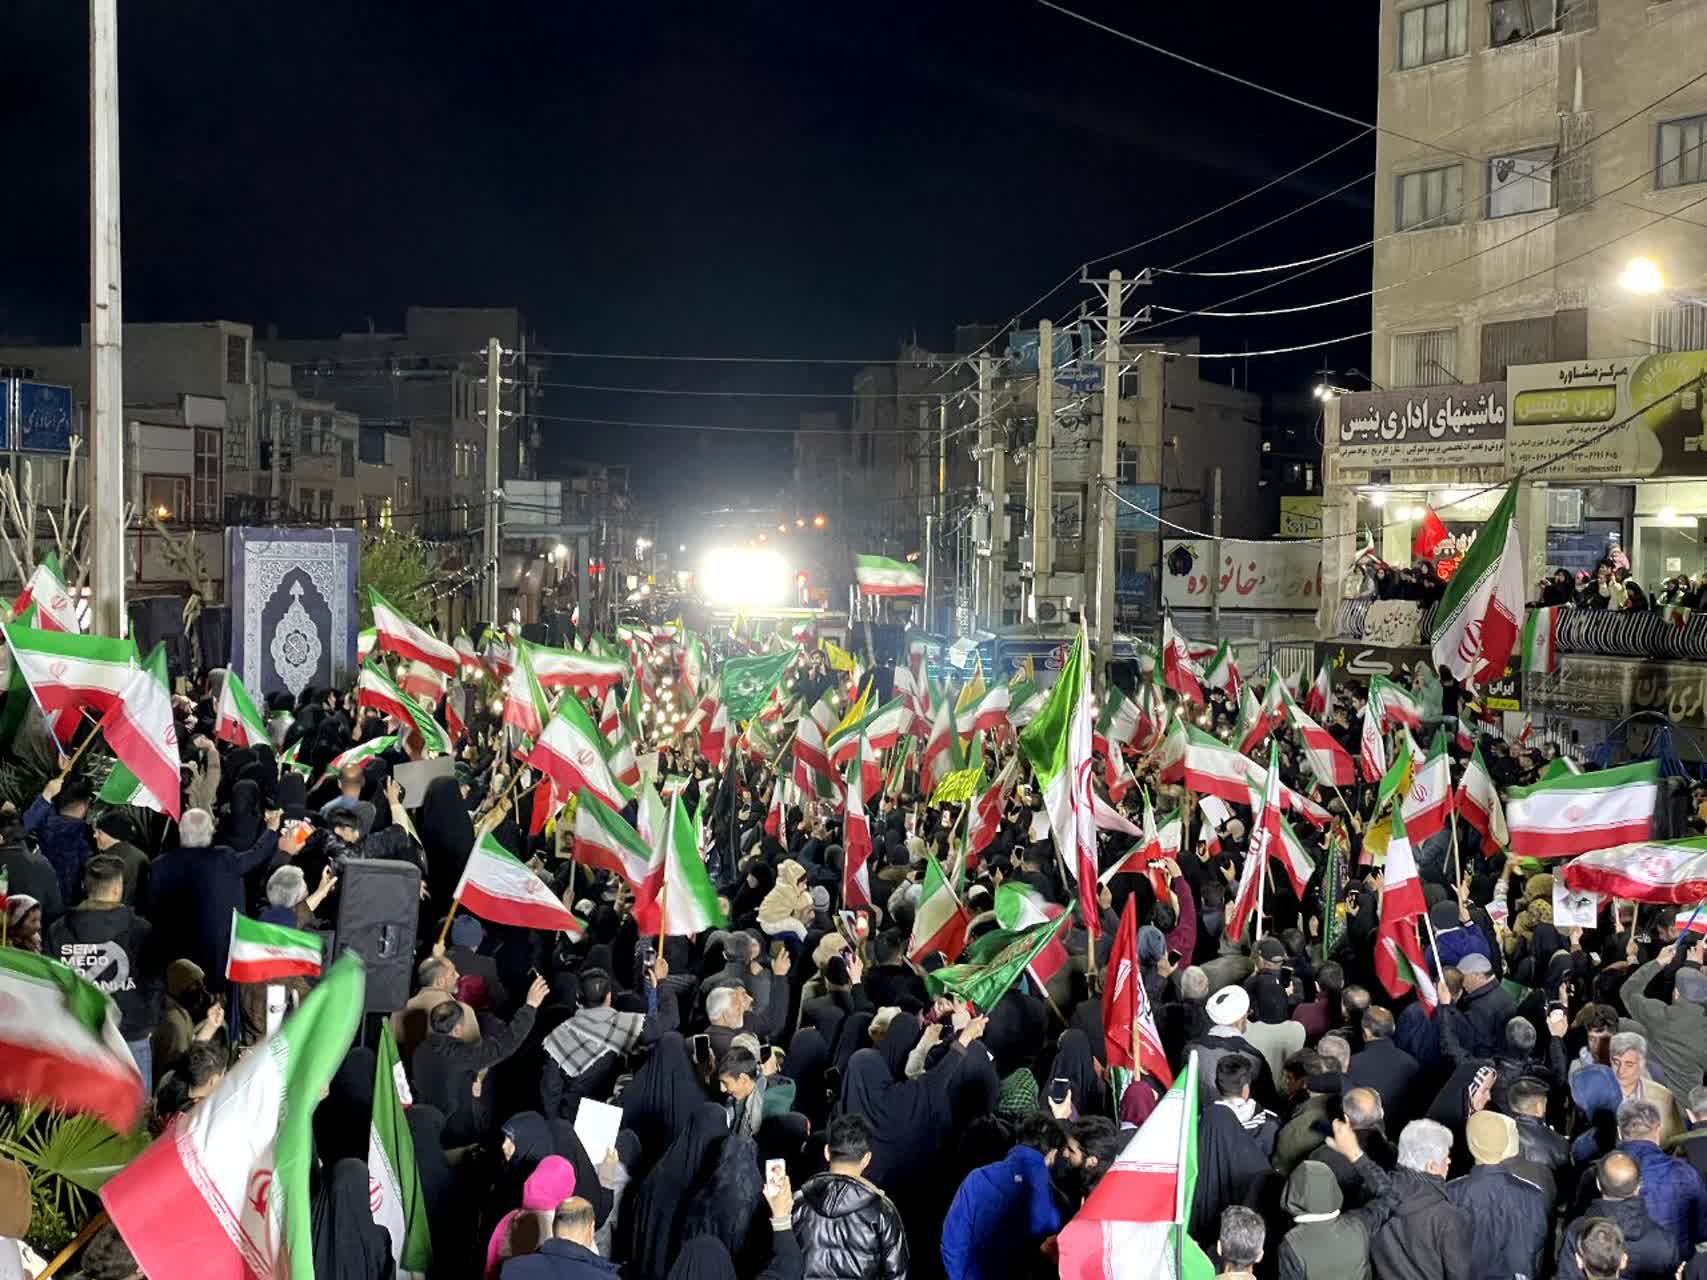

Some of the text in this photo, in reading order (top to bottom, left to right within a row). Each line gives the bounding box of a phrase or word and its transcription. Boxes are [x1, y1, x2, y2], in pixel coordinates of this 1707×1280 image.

[1559, 363, 1598, 384] مشاوره
[1598, 364, 1628, 382] مرکز
[1381, 398, 1428, 439] اداری
[1429, 392, 1505, 438] ماشینهای
[61, 944, 98, 955] SEM
[61, 956, 109, 966] MEDO
[93, 977, 137, 991] ANHÃ
